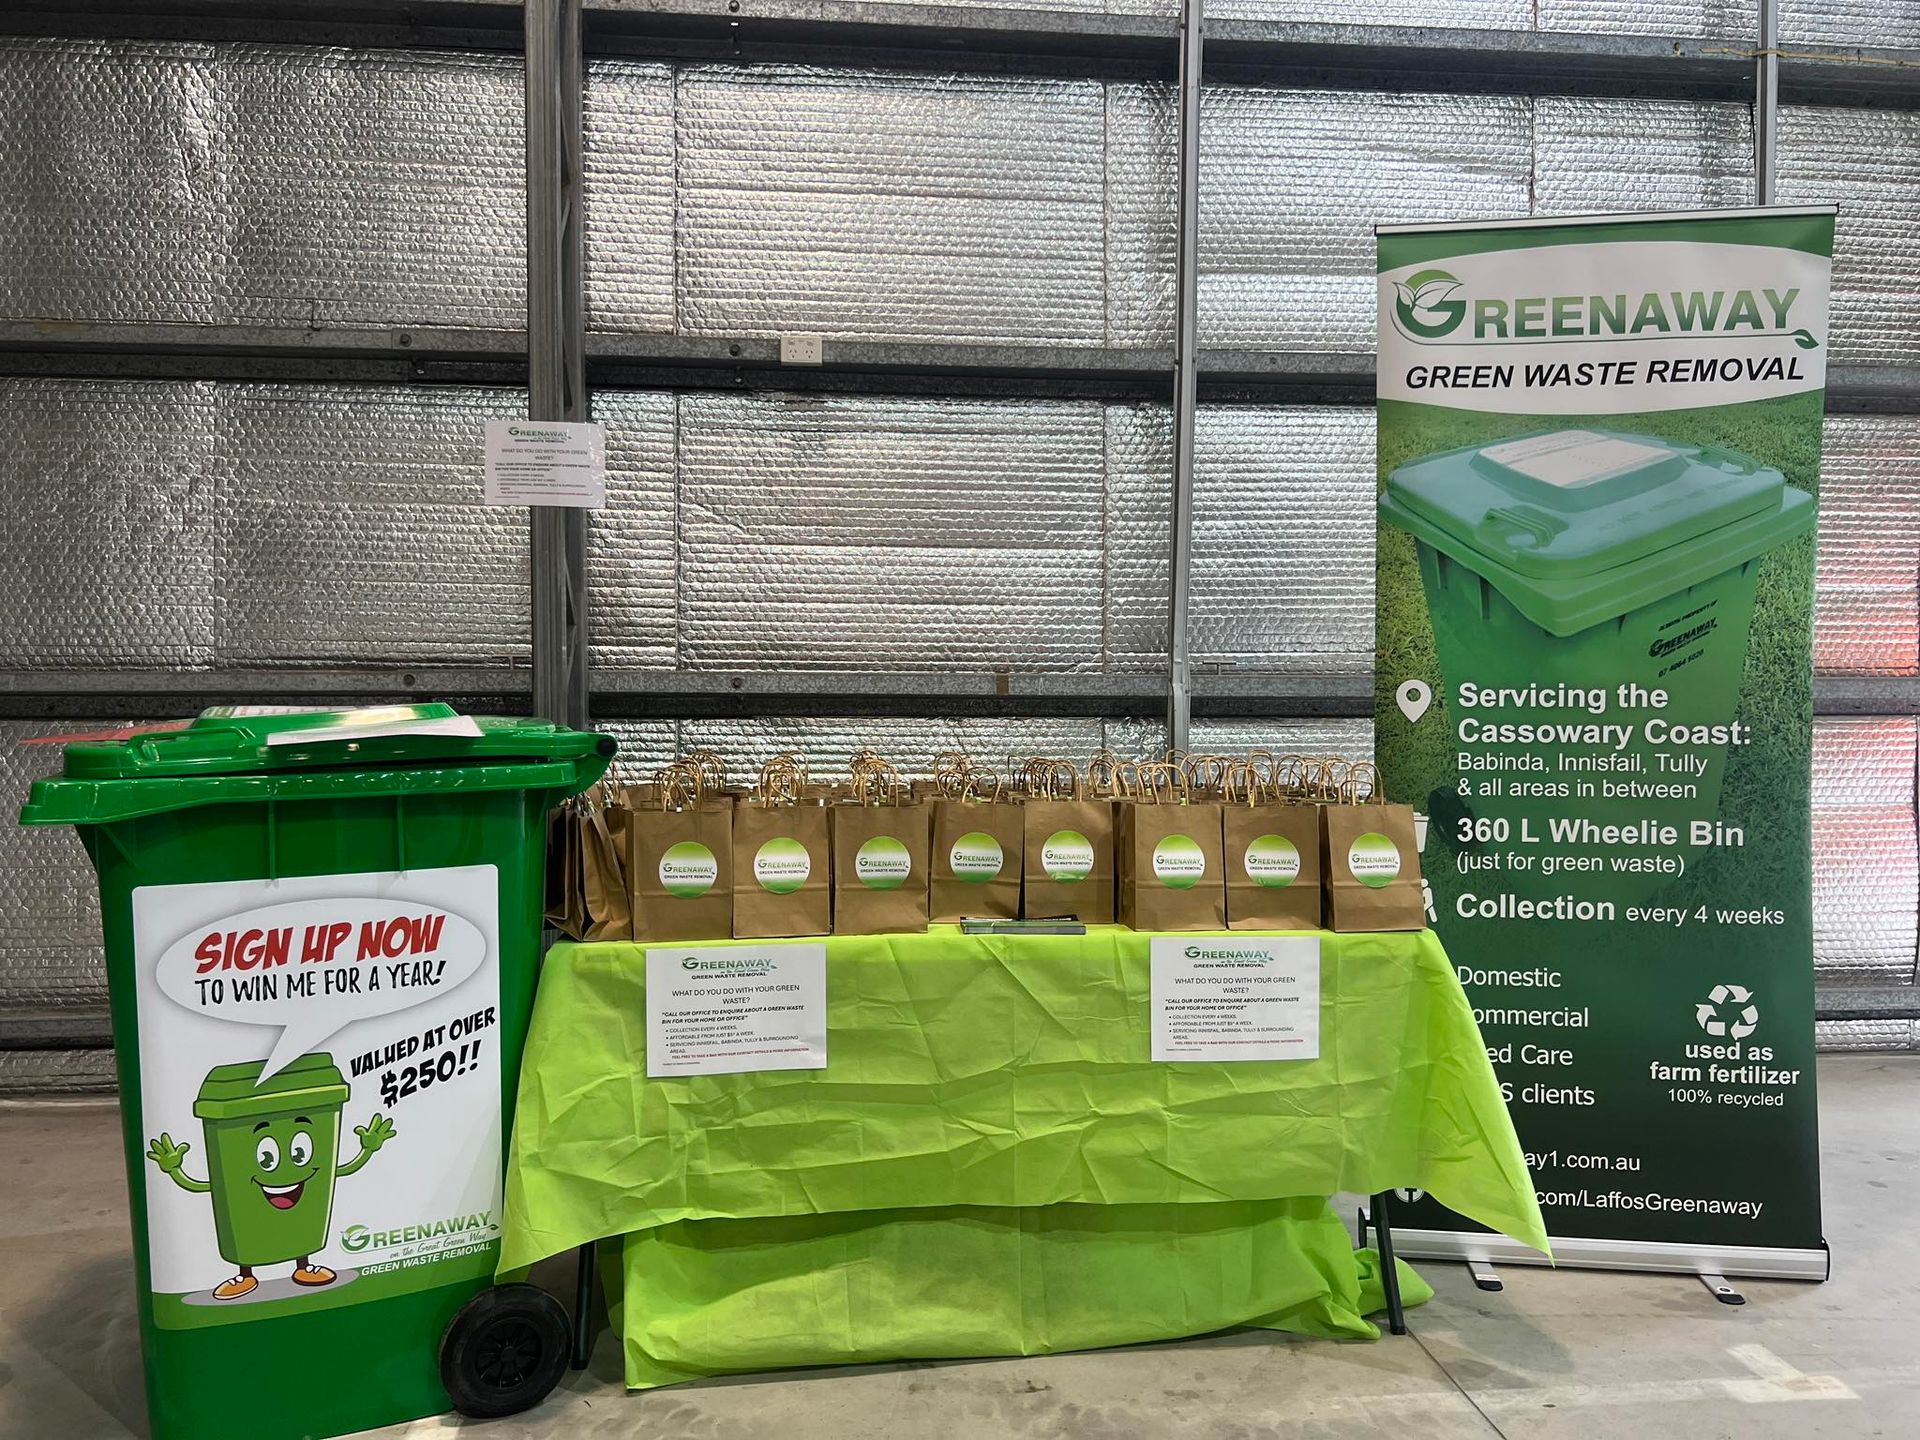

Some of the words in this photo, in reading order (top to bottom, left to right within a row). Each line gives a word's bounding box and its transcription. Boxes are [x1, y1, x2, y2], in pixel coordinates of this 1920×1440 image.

[1394, 269, 1800, 339] GREENAWAY
[1405, 365, 1515, 389] GREEN
[1524, 362, 1637, 387] WASTE
[1645, 357, 1805, 385] REMOVAL
[1458, 681, 1607, 714] Servicing
[1617, 683, 1669, 709] the
[1458, 718, 1634, 750] Cassowary
[1644, 719, 1752, 746] Coast:
[1458, 752, 1550, 774] Babinda,
[1558, 753, 1647, 775] Innisfail,
[1656, 753, 1708, 777] Tully
[1457, 778, 1473, 797] &
[1478, 778, 1502, 797] all
[1509, 783, 1570, 798] areas
[1577, 779, 1594, 798] in
[1602, 779, 1697, 799] between
[1456, 817, 1510, 844] 360
[1521, 818, 1540, 843] L
[1549, 818, 1678, 845] Wheelie
[1689, 820, 1745, 846] Bin
[663, 863, 712, 873] GREENAWAY
[1456, 853, 1501, 875] (just
[1506, 853, 1535, 871] for
[1541, 857, 1603, 876] green
[1610, 855, 1685, 878] waste)
[1456, 893, 1615, 921] Collection
[1625, 907, 1687, 926] every
[1694, 906, 1708, 923] 4
[1716, 907, 1785, 925] weeks
[194, 926, 294, 973] SIGN
[300, 921, 353, 965] UP
[356, 914, 446, 962] NOW
[1185, 946, 1269, 958] GREENAWAY
[682, 957, 772, 969] GREENAWAY
[194, 978, 224, 1005] TO
[232, 974, 278, 1003] WIN
[287, 970, 317, 998] ME
[324, 967, 361, 995] FOR
[369, 965, 380, 991] A
[387, 960, 446, 988] YEAR!
[754, 985, 775, 993] YOUR
[775, 984, 800, 992] GREEN
[1457, 966, 1561, 988] Domestic
[1472, 1007, 1589, 1028] ommercial
[350, 1036, 419, 1078] VALUED
[422, 1025, 446, 1051] AT
[449, 1006, 496, 1041] OVER
[1486, 1043, 1512, 1064] ed
[1520, 1044, 1573, 1065] Care
[1685, 1041, 1741, 1061] used
[1747, 1045, 1774, 1061] as
[381, 1039, 481, 1108] $250!!
[1650, 1061, 1701, 1082] farm
[1708, 1064, 1801, 1086] fertilizer
[1500, 1082, 1514, 1102] S
[1521, 1082, 1595, 1106] clients
[1668, 1089, 1713, 1105] 100%
[1717, 1090, 1784, 1110] recycled
[1524, 1150, 1640, 1171] ay1.com.au
[1536, 1189, 1763, 1220] com/LaffosGreenaway
[340, 1211, 492, 1251] GREENAWAY
[361, 1261, 400, 1276] GREEN
[402, 1252, 441, 1269] WASTE
[442, 1241, 492, 1261] REMOVAL
